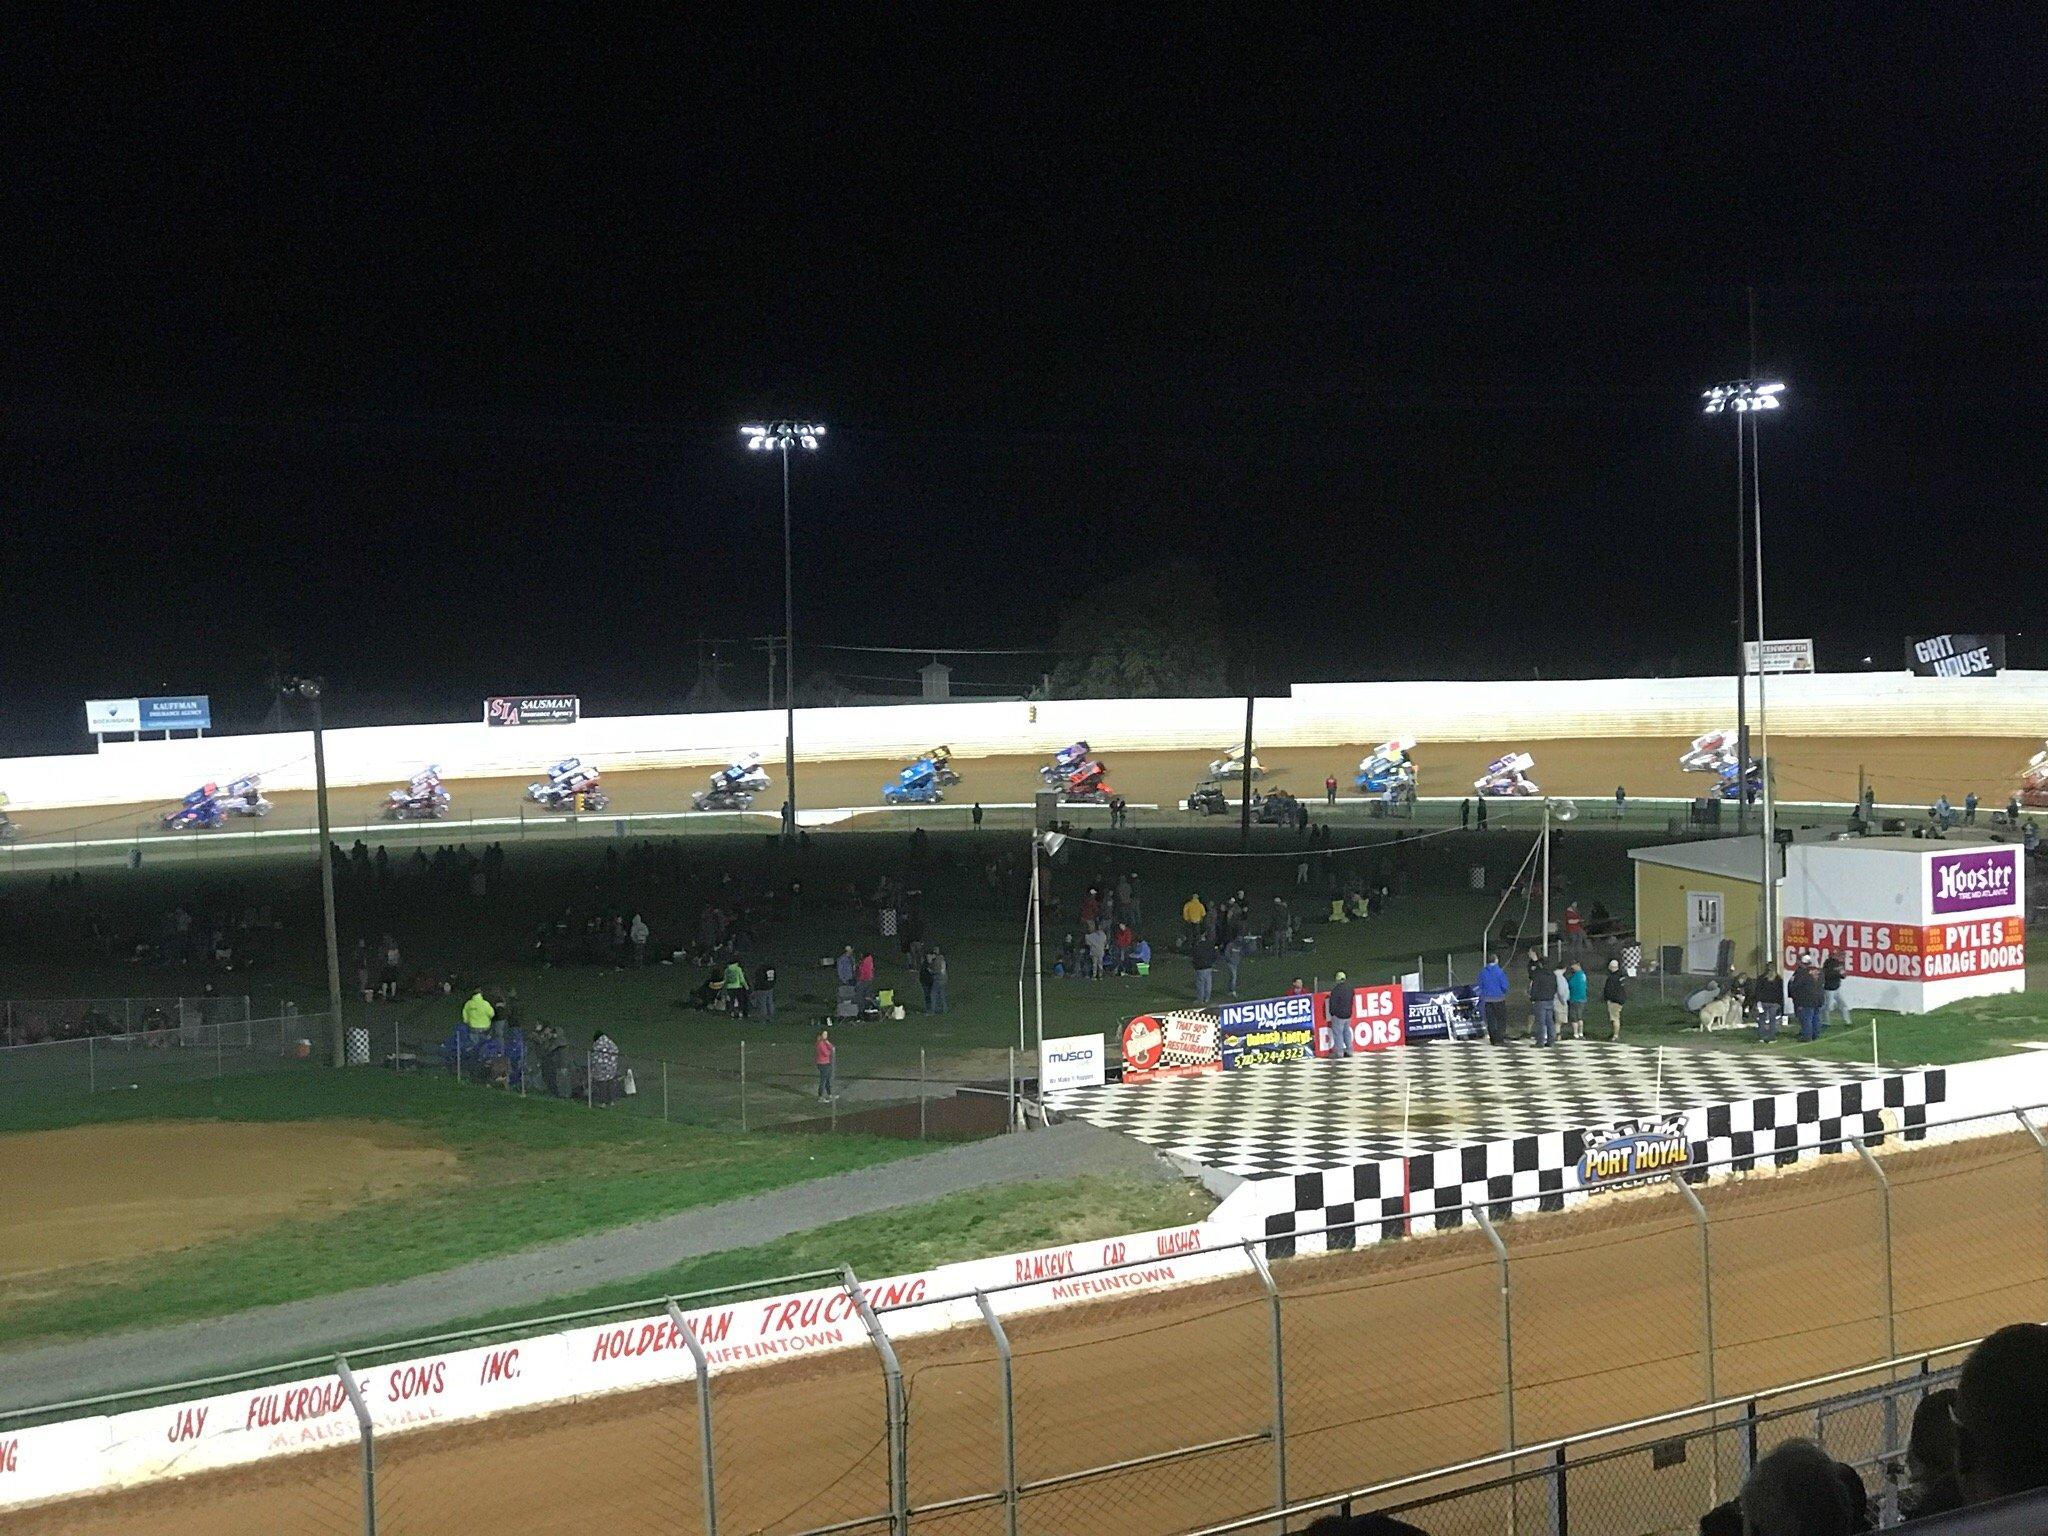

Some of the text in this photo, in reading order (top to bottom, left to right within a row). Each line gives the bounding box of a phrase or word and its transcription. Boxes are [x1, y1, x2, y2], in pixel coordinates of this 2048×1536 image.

[1915, 634, 1954, 664] GRIT
[1933, 646, 1994, 677] HOUSE
[153, 701, 197, 710] KAUFFMAN
[490, 699, 520, 725] SIA
[520, 699, 573, 709] SAUSMAN
[551, 710, 573, 718] Agency
[1937, 858, 2012, 899] Hoosier
[1813, 922, 1891, 950] PYLES
[1945, 921, 2004, 950] PYLES
[1860, 951, 1922, 977] DOORS
[1924, 943, 2025, 977] GARAGE DOORS
[1175, 1020, 1192, 1031] THAT
[1223, 998, 1311, 1026] INSINGER
[1409, 1005, 1438, 1018] RIVER
[1180, 1032, 1201, 1043] STYLE
[1319, 1017, 1401, 1051] DORS
[1584, 1137, 1688, 1179] PORT ROYAL
[1103, 1242, 1126, 1267] CAR
[1157, 1229, 1201, 1256] WASHES
[1052, 1266, 1176, 1300] MIFFLINTOWN
[168, 1406, 209, 1443] JAY
[245, 1379, 347, 1431] FULKROAD
[388, 1361, 446, 1402] SONS
[480, 1348, 522, 1386] INC.
